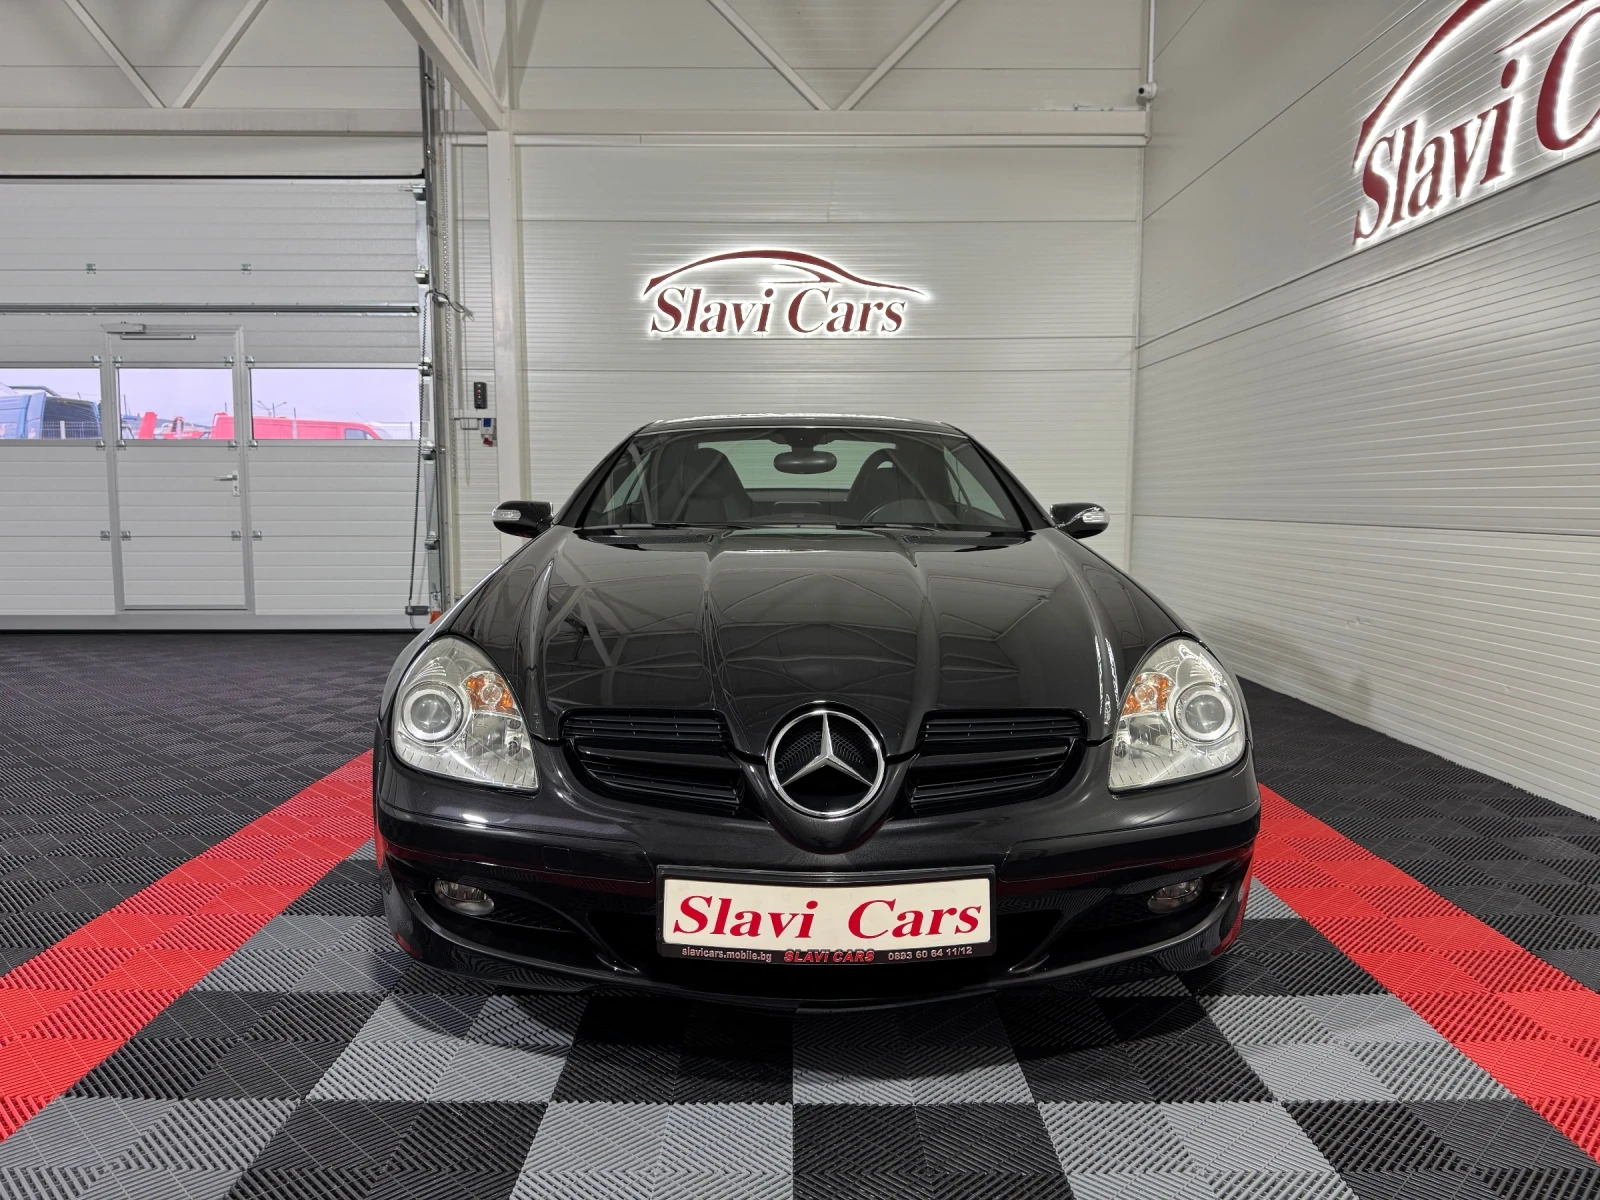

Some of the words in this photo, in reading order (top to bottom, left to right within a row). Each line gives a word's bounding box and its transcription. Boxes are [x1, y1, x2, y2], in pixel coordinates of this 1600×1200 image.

[1353, 58, 1518, 246] Slavi
[651, 287, 774, 333] Slavi
[788, 287, 906, 333] Cars
[673, 895, 818, 939] Slavi
[848, 898, 982, 939] Cars
[682, 946, 772, 963] slavicars.mobile.bg
[783, 950, 830, 963] SLAVI
[832, 950, 875, 963] CARS
[888, 952, 913, 961] 0893
[915, 950, 928, 960] 60
[930, 948, 944, 958] 64
[945, 946, 973, 956] 11/12
